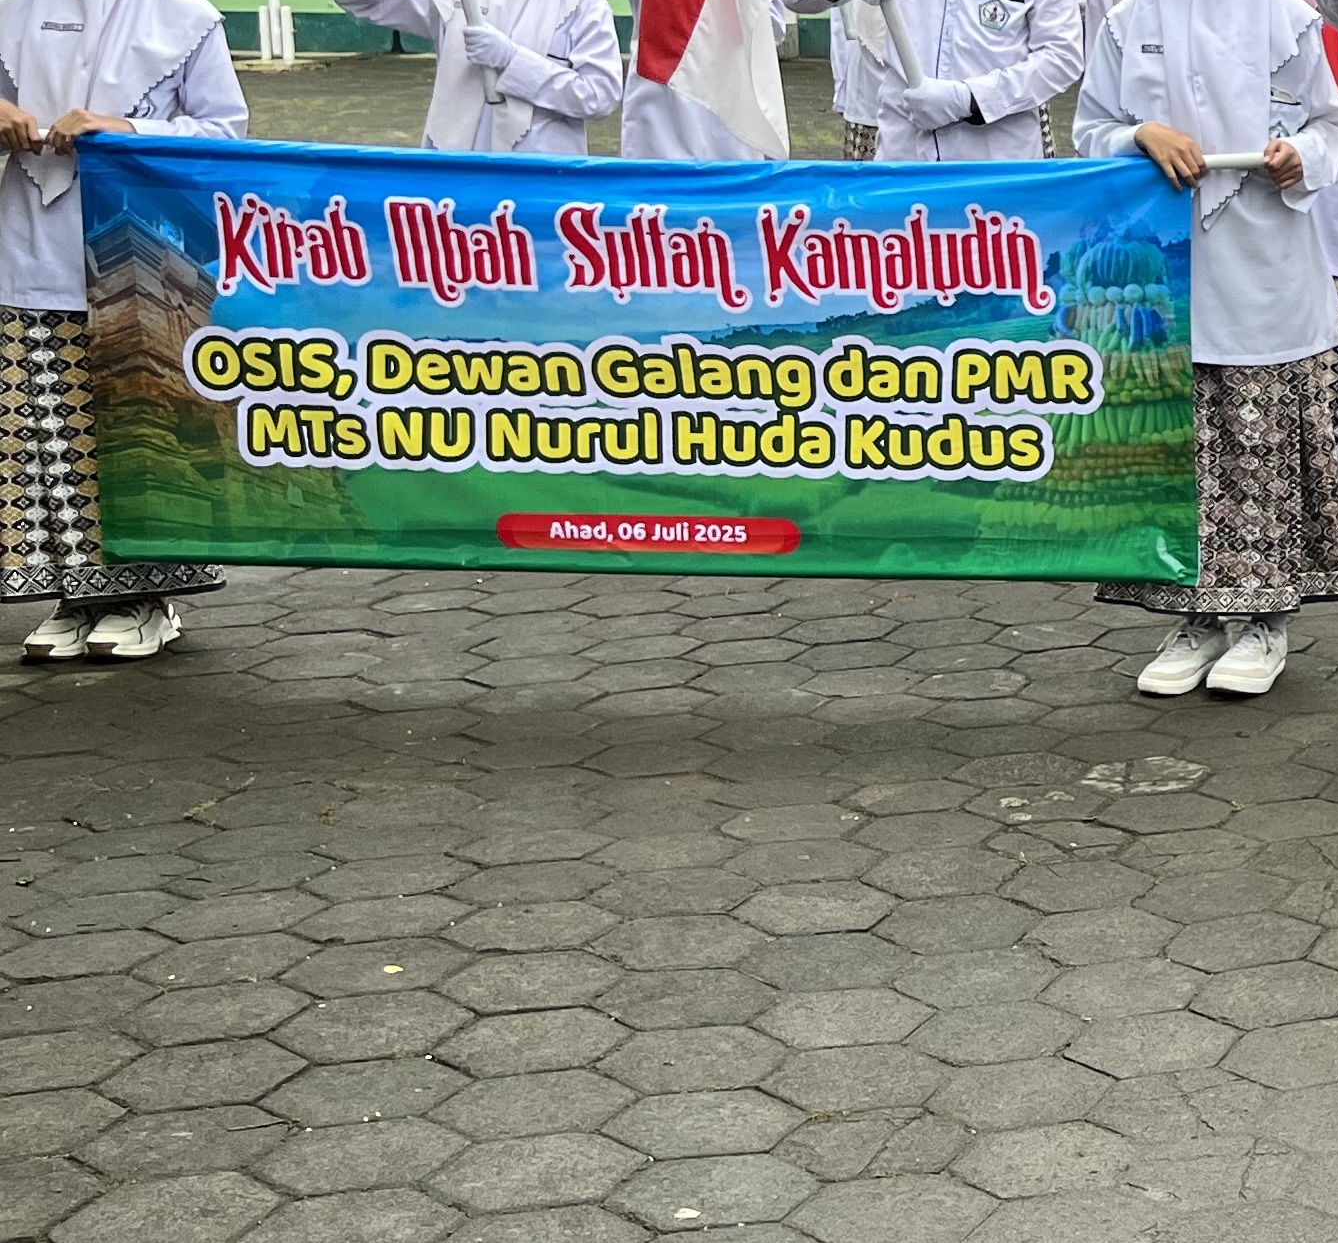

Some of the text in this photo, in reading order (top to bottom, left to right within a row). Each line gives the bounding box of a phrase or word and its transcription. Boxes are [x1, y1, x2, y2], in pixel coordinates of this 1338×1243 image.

[216, 196, 1053, 311] Kirab Mbah Sultan Kamaludin
[194, 337, 1093, 411] OSIS, Dewan Galang dan PMR
[249, 403, 1044, 470] MTs NU Nurul Huda Kudus
[550, 520, 748, 543] Ahad, 06 Juli 2025
